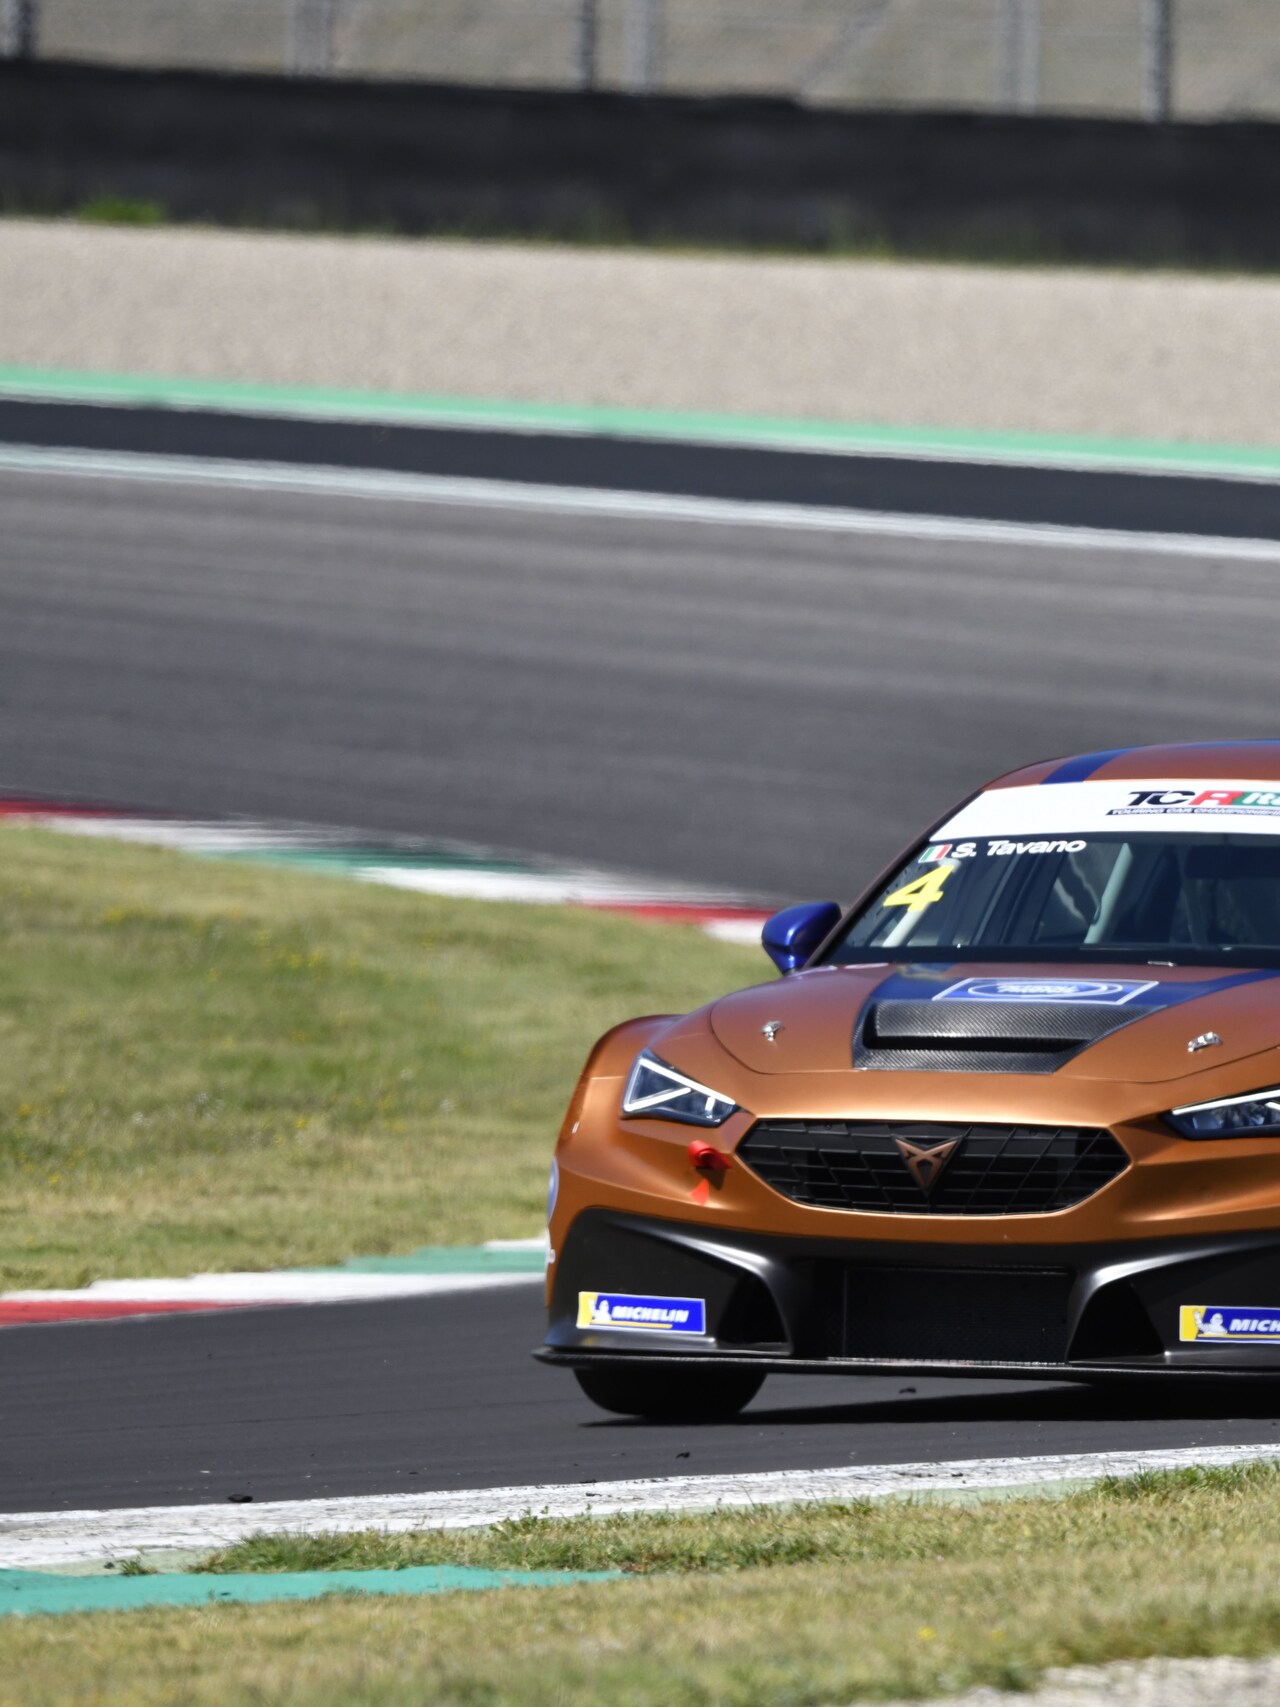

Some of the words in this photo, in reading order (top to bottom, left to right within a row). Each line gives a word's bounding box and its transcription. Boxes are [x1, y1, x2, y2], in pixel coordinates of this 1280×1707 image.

[1127, 790, 1243, 807] TCR
[1110, 808, 1164, 816] TOURING
[951, 842, 977, 859] S.
[987, 839, 1087, 857] Tavano
[882, 864, 955, 912] 4
[611, 1305, 690, 1323] MICHELIN
